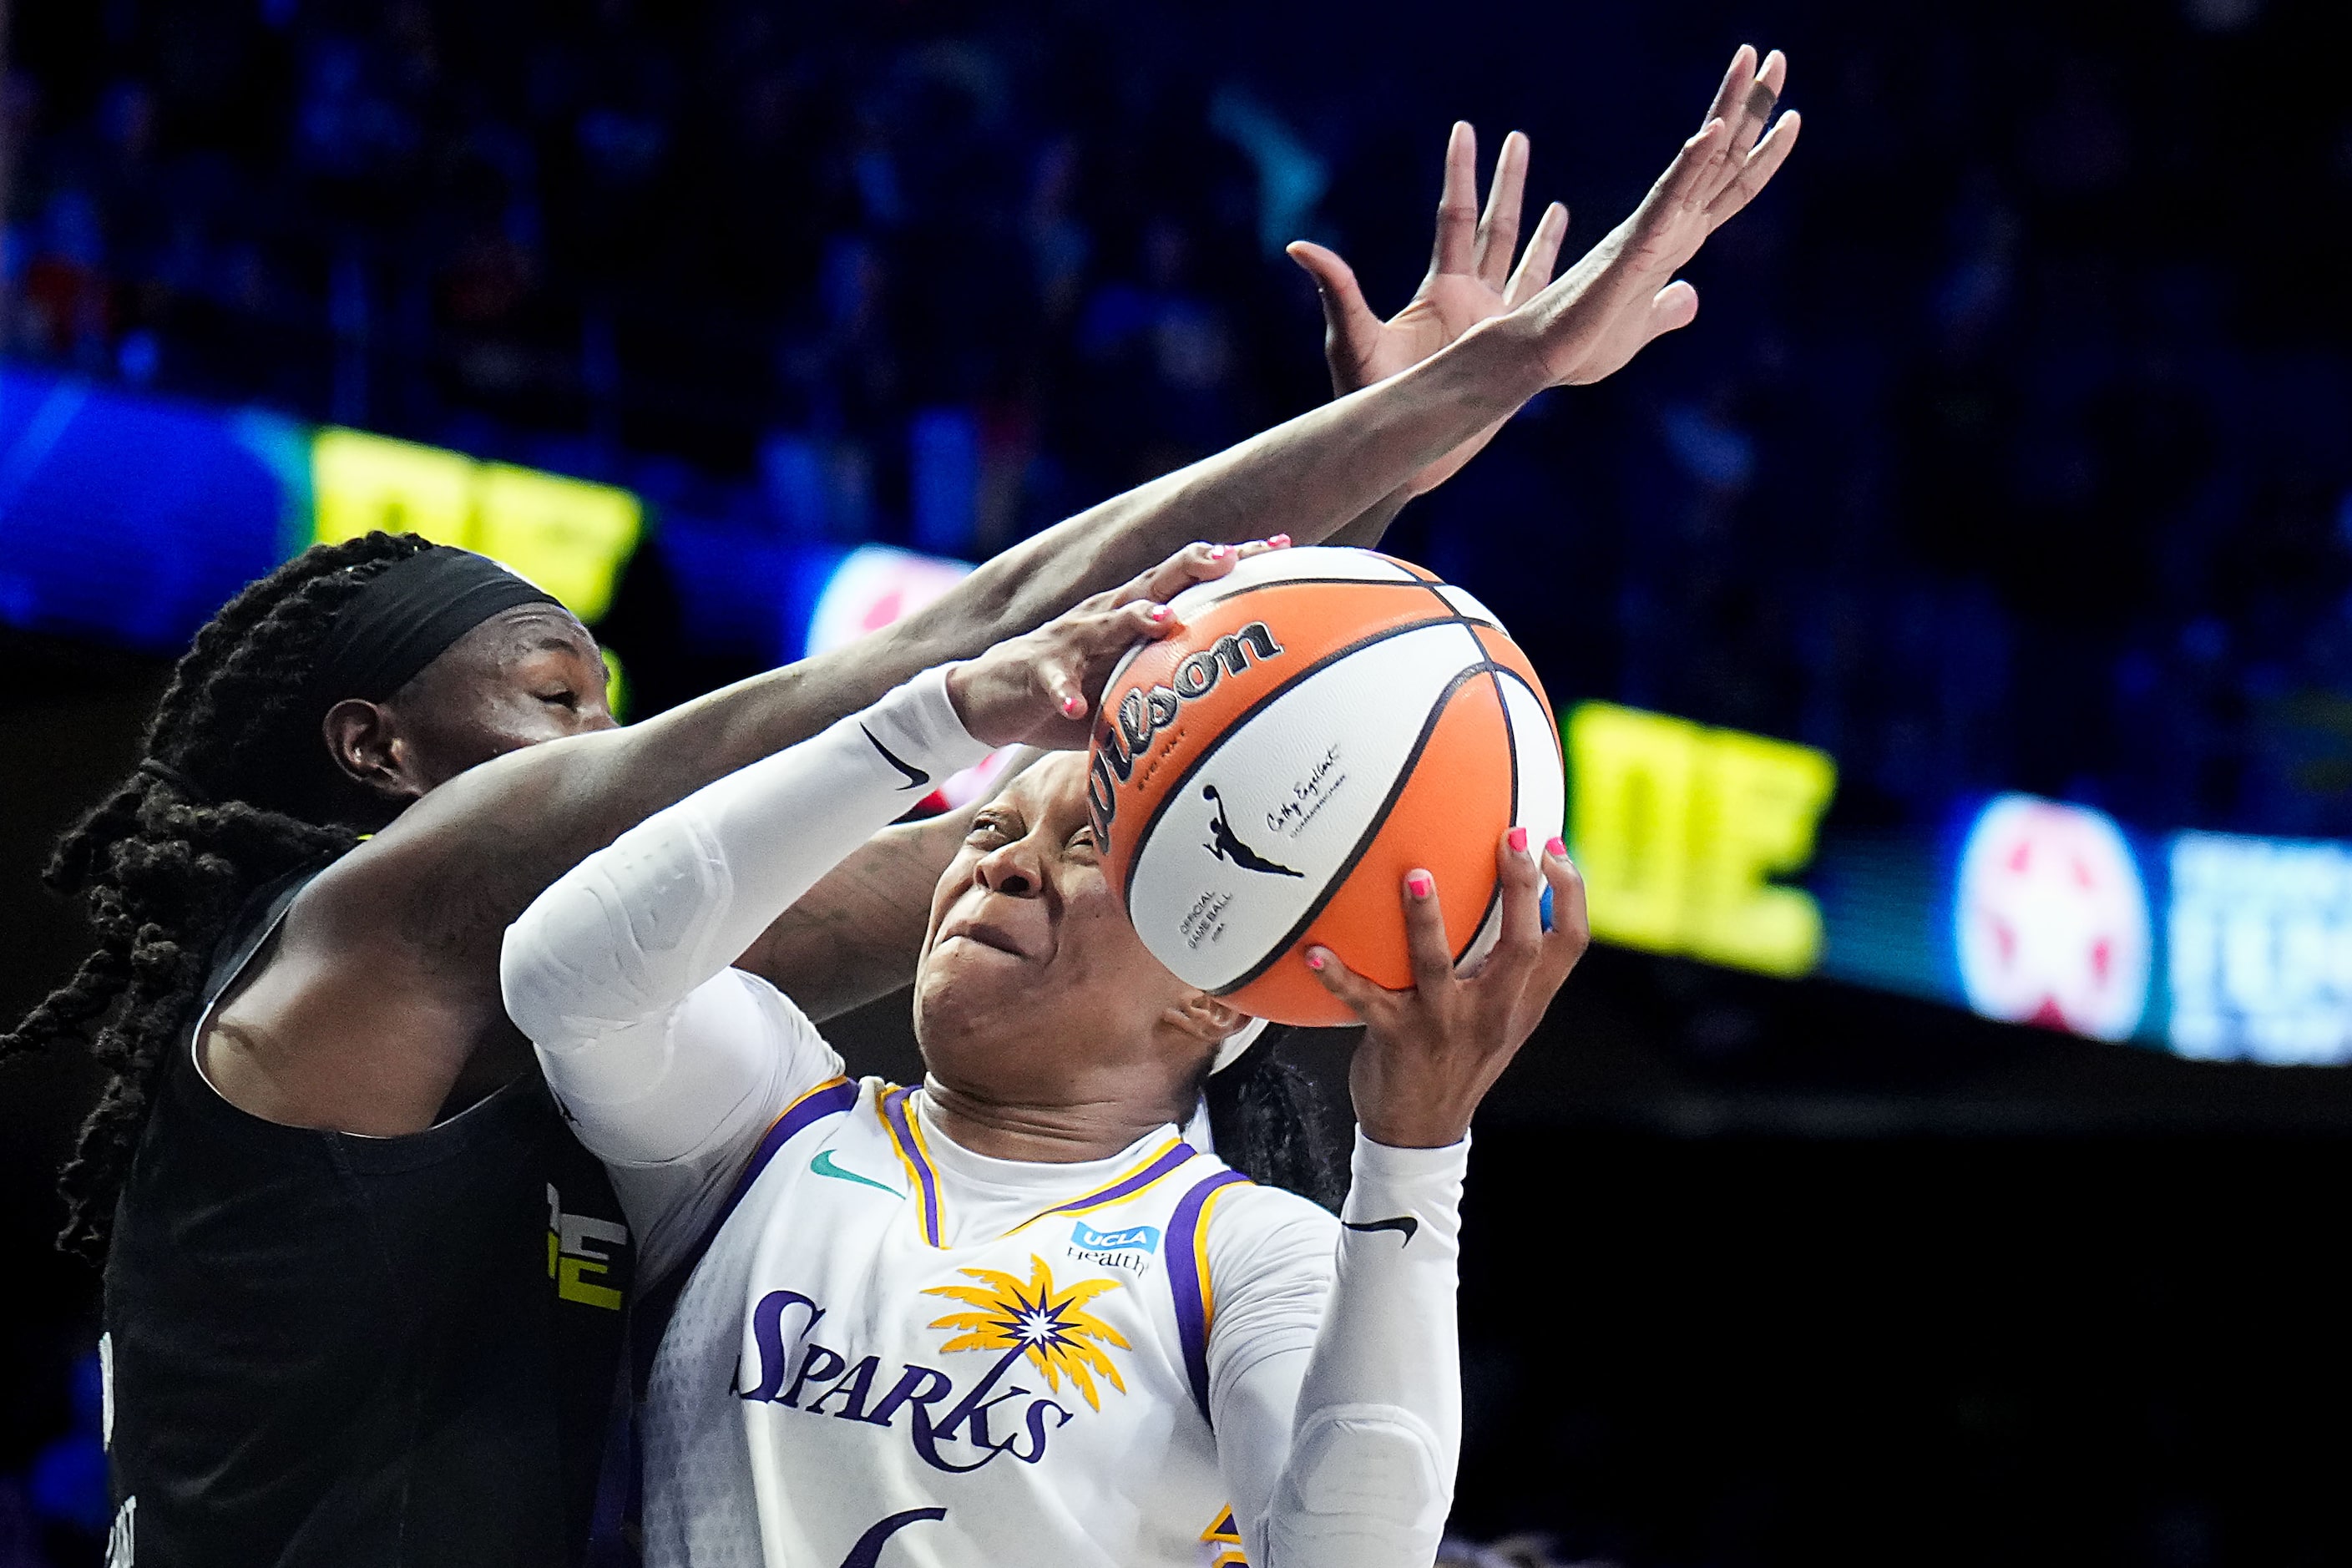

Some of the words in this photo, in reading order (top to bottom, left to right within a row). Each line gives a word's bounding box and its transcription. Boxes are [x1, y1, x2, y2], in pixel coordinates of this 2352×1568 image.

[1179, 891, 1216, 935] OFFICIAL
[1187, 918, 1212, 949] GAME
[1206, 892, 1234, 923] BALL
[1083, 1230, 1147, 1247] UCLA
[1067, 1247, 1146, 1279] Health
